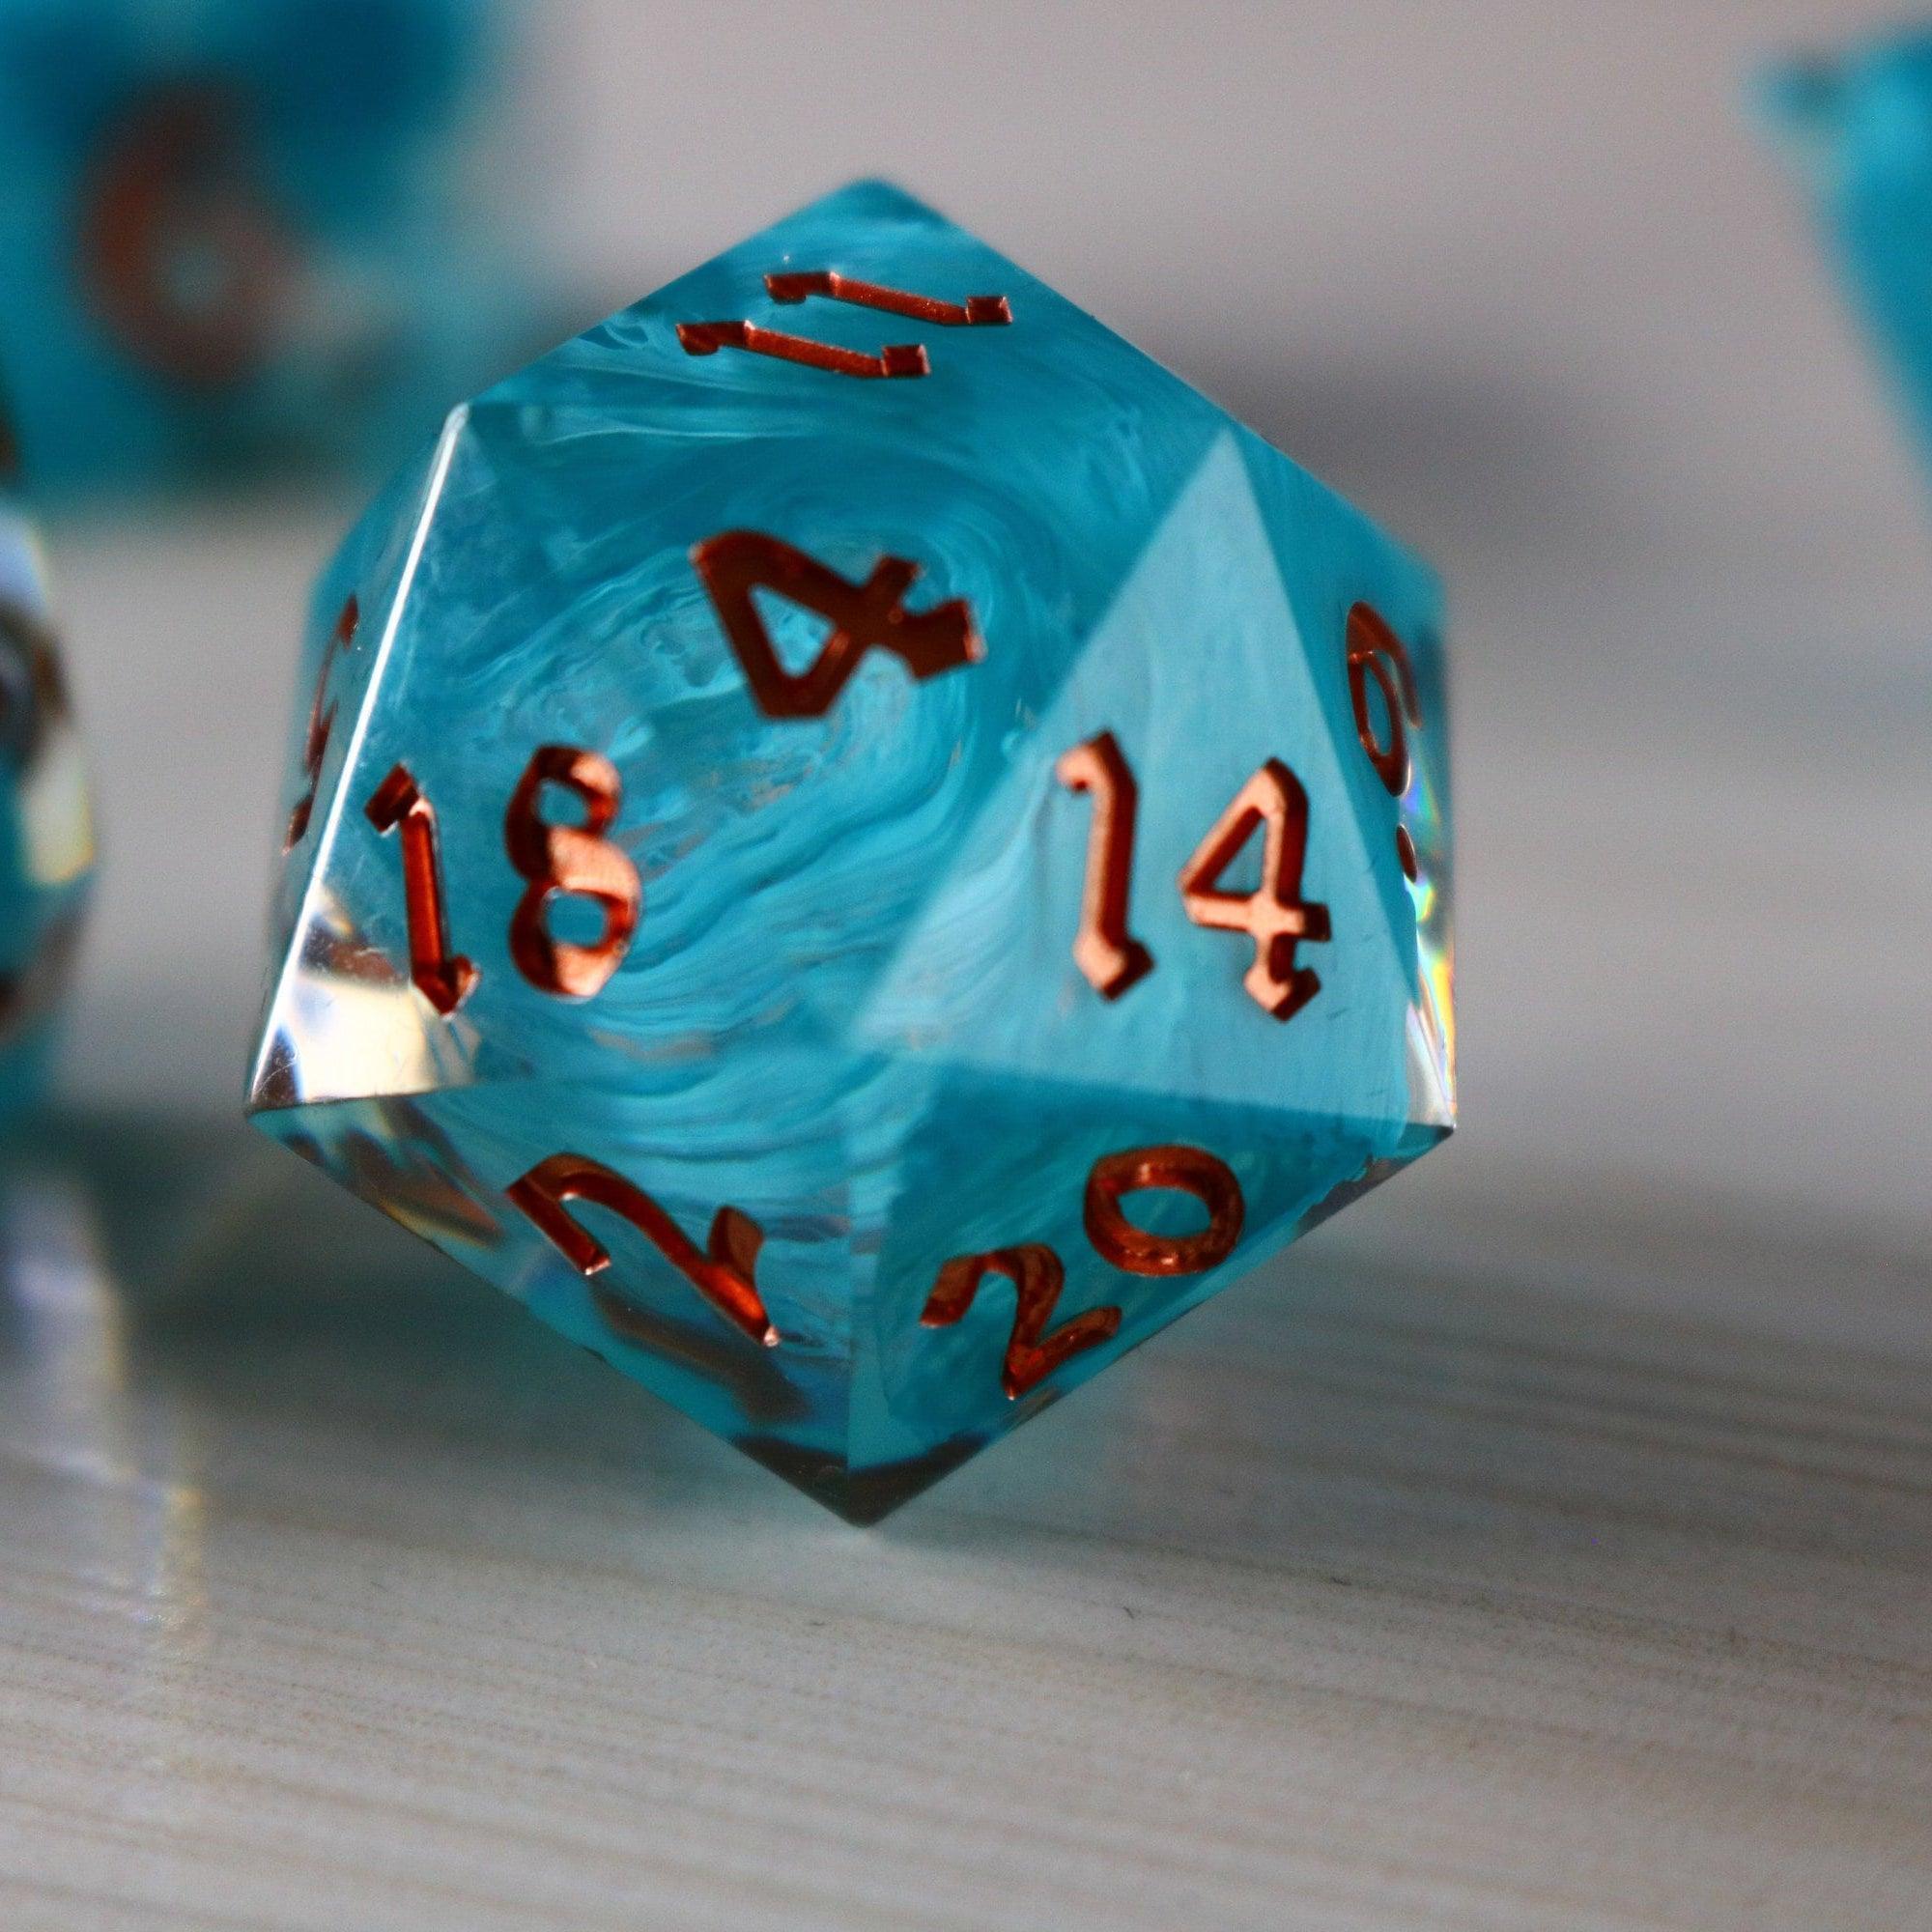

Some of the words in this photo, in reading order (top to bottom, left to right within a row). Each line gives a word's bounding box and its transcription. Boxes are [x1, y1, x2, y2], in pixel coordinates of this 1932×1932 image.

[676, 270, 1012, 379] 11
[690, 528, 987, 718] 4
[364, 743, 643, 1016] 18
[1057, 728, 1332, 1023] 14
[920, 1144, 1245, 1400] 20
